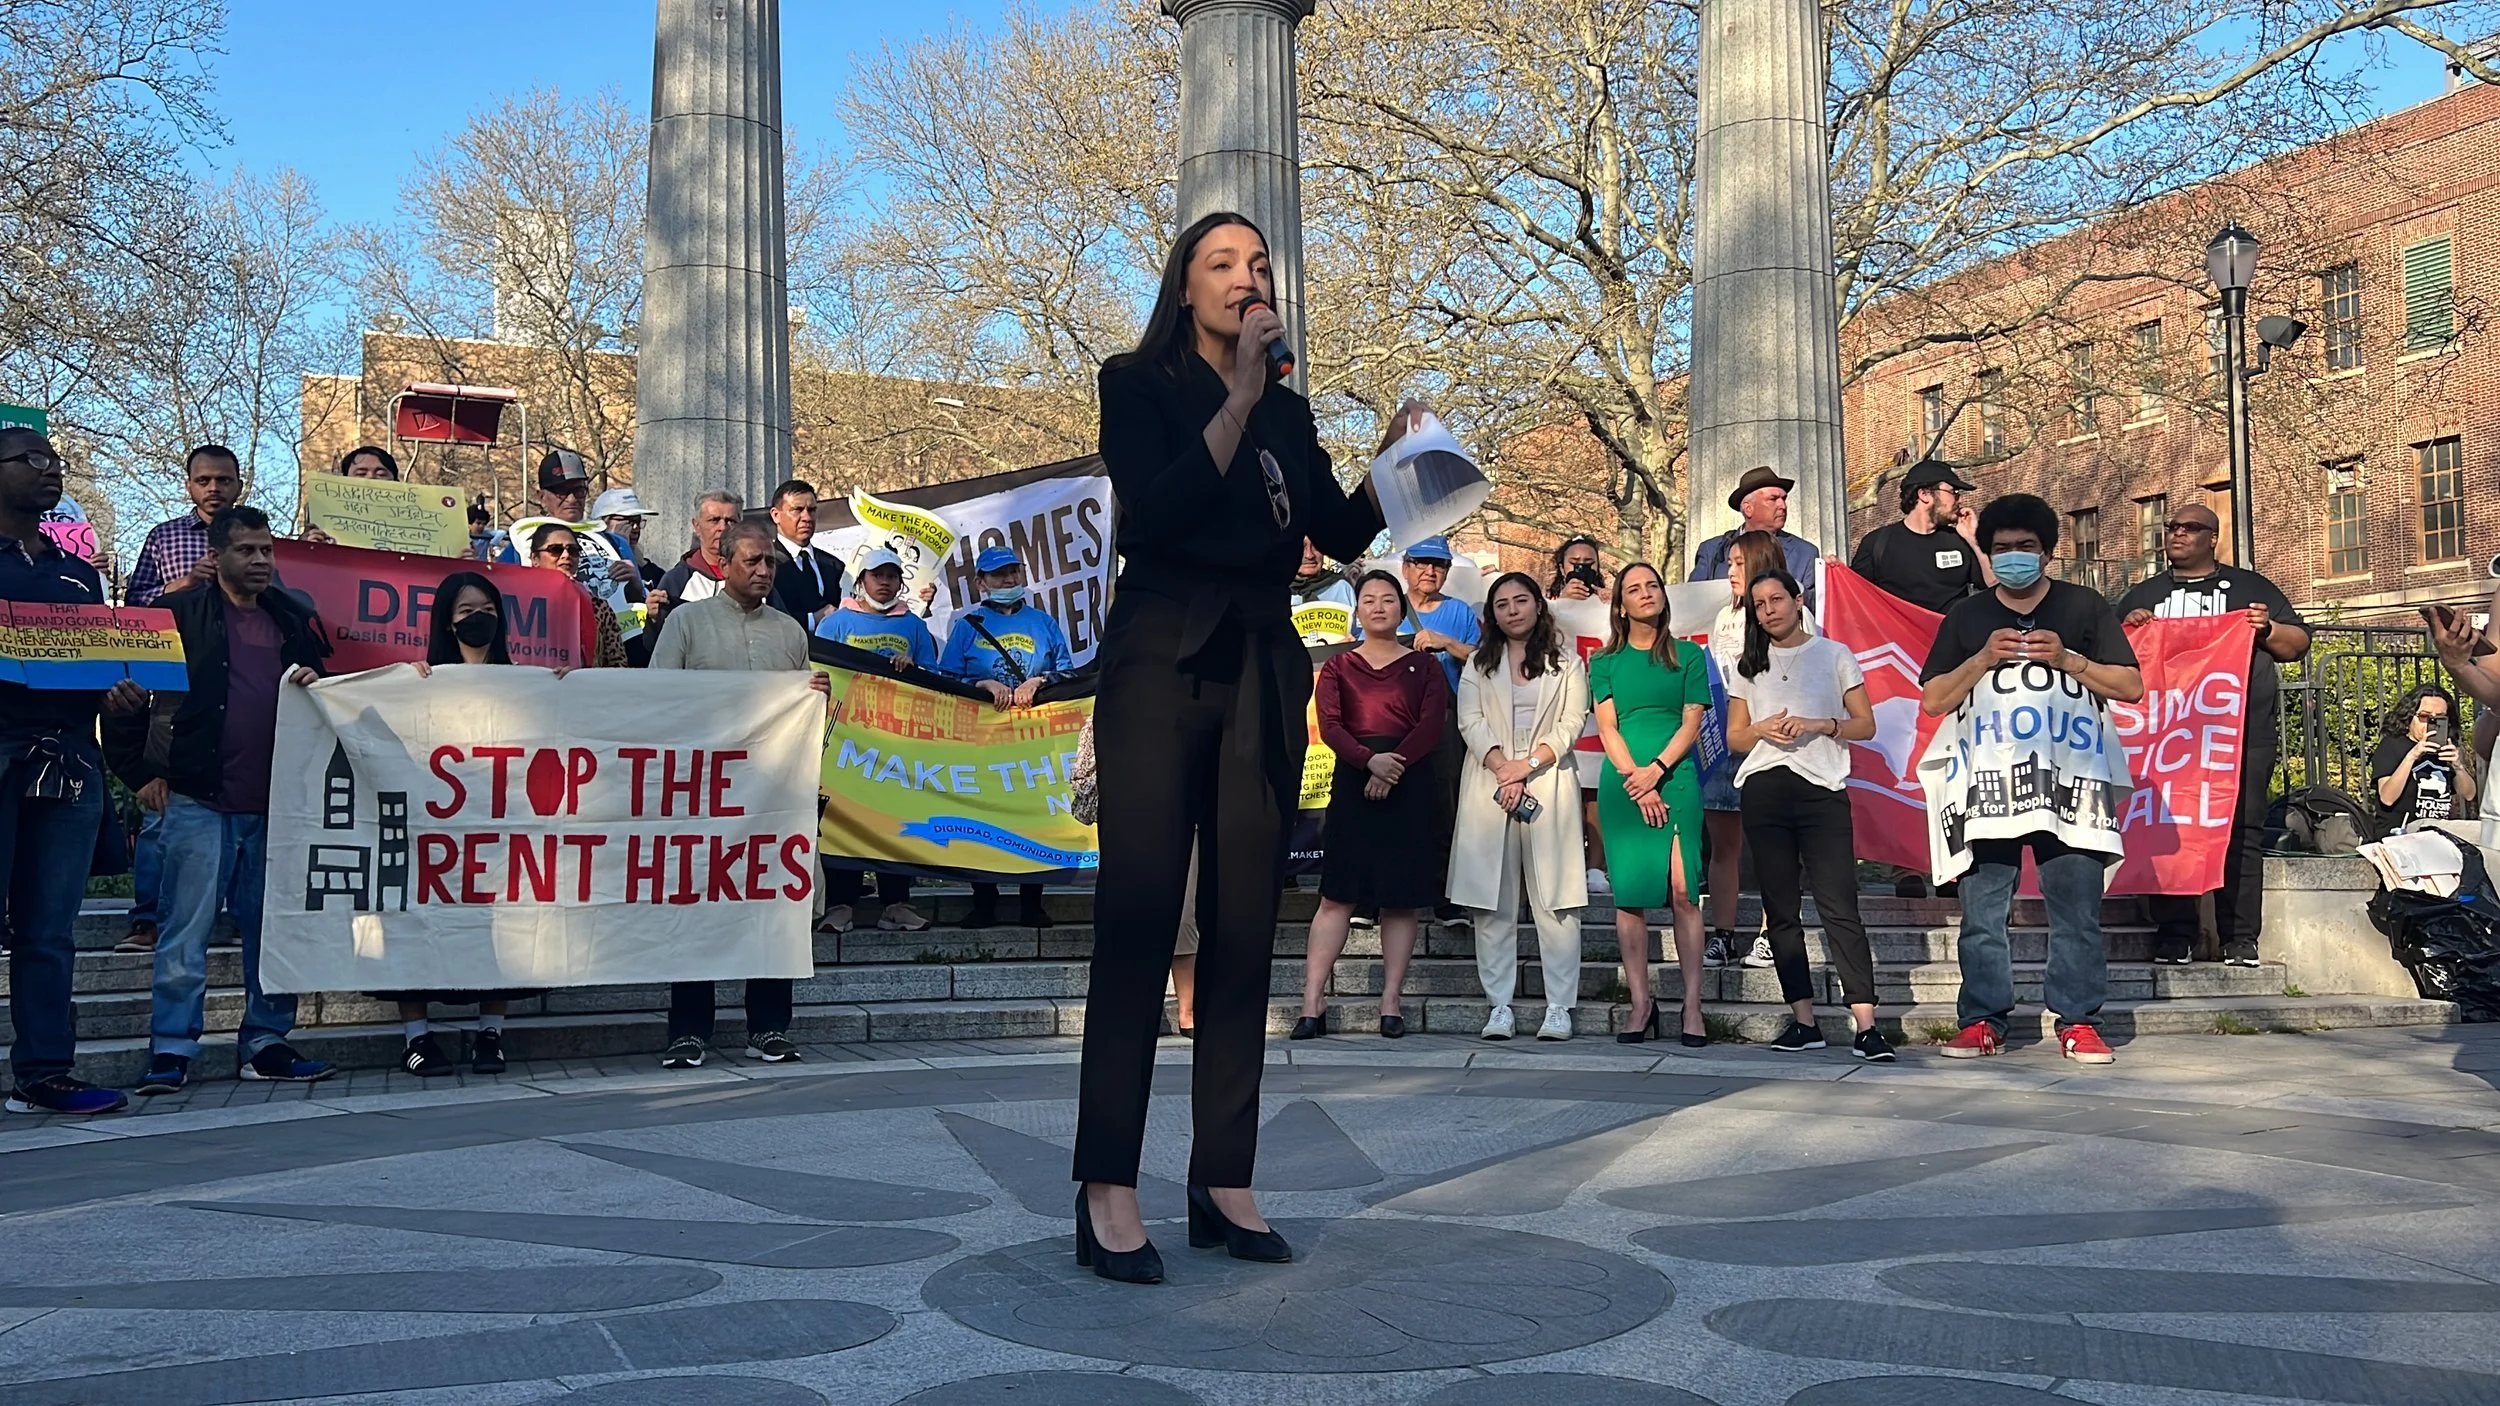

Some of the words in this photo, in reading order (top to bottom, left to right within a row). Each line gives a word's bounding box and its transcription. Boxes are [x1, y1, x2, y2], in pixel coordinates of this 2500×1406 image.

[38, 526, 96, 558] ASS
[866, 506, 897, 522] MAKE
[899, 514, 921, 527] THE
[922, 523, 951, 545] ROAD
[903, 525, 925, 537] NEW
[924, 534, 945, 553] YORK
[49, 603, 80, 614] THAT
[1295, 612, 1316, 625] THE
[1317, 611, 1347, 623] ROAD
[1302, 621, 1322, 631] NEW
[1324, 622, 1345, 632] YORK
[14, 635, 109, 648] RENEWABLES
[136, 639, 173, 650] FIGHT
[73, 628, 108, 638] PASS
[119, 627, 160, 640] GOOD
[336, 626, 387, 643] Desis
[394, 632, 428, 648] Risi
[507, 641, 570, 662] Moving
[2108, 671, 2242, 737] SING
[837, 738, 981, 794] MAKE
[2124, 724, 2239, 782] TICE
[425, 745, 597, 819] STOP
[617, 748, 748, 818] THE
[1982, 801, 2006, 815] for
[2120, 780, 2231, 834] ALL
[933, 823, 993, 842] DIGNIDAD,
[996, 835, 1063, 862] COMUNIDAD
[1065, 855, 1074, 864] Y
[416, 832, 608, 905] RENT
[625, 834, 812, 905] HIKES
